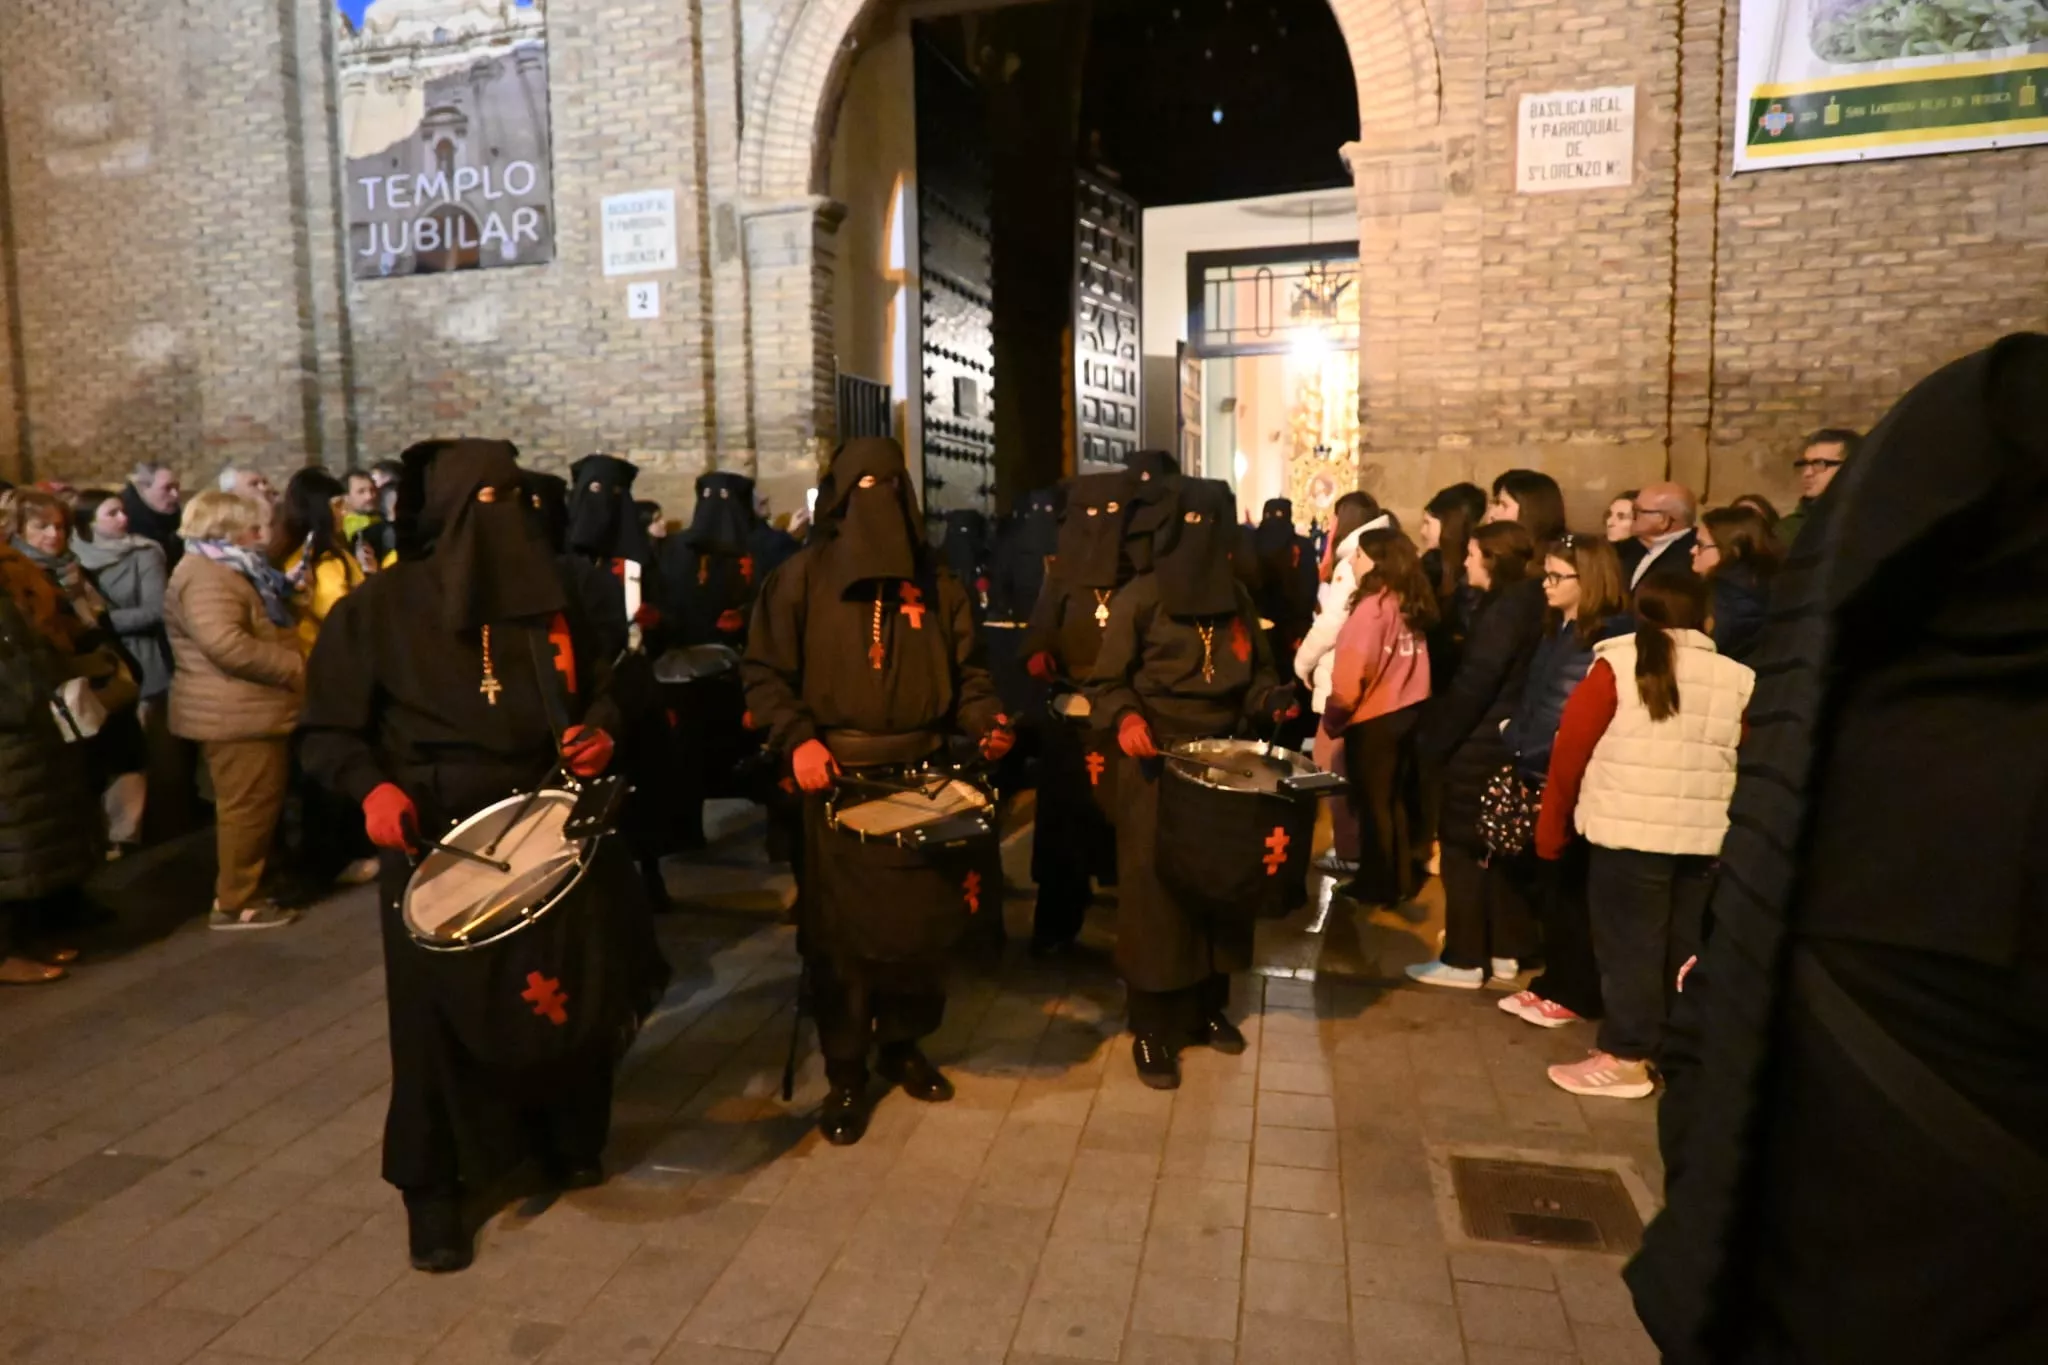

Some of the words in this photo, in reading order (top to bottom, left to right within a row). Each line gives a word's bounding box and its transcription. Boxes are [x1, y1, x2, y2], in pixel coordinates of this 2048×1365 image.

[1590, 96, 1622, 114] REAL
[1530, 124, 1538, 139] Y
[1542, 117, 1624, 140] PARROQUIAL
[1565, 141, 1583, 158] DE
[358, 160, 536, 211] TEMPLO
[360, 206, 539, 257] JUBILAR
[637, 290, 648, 310] 2
